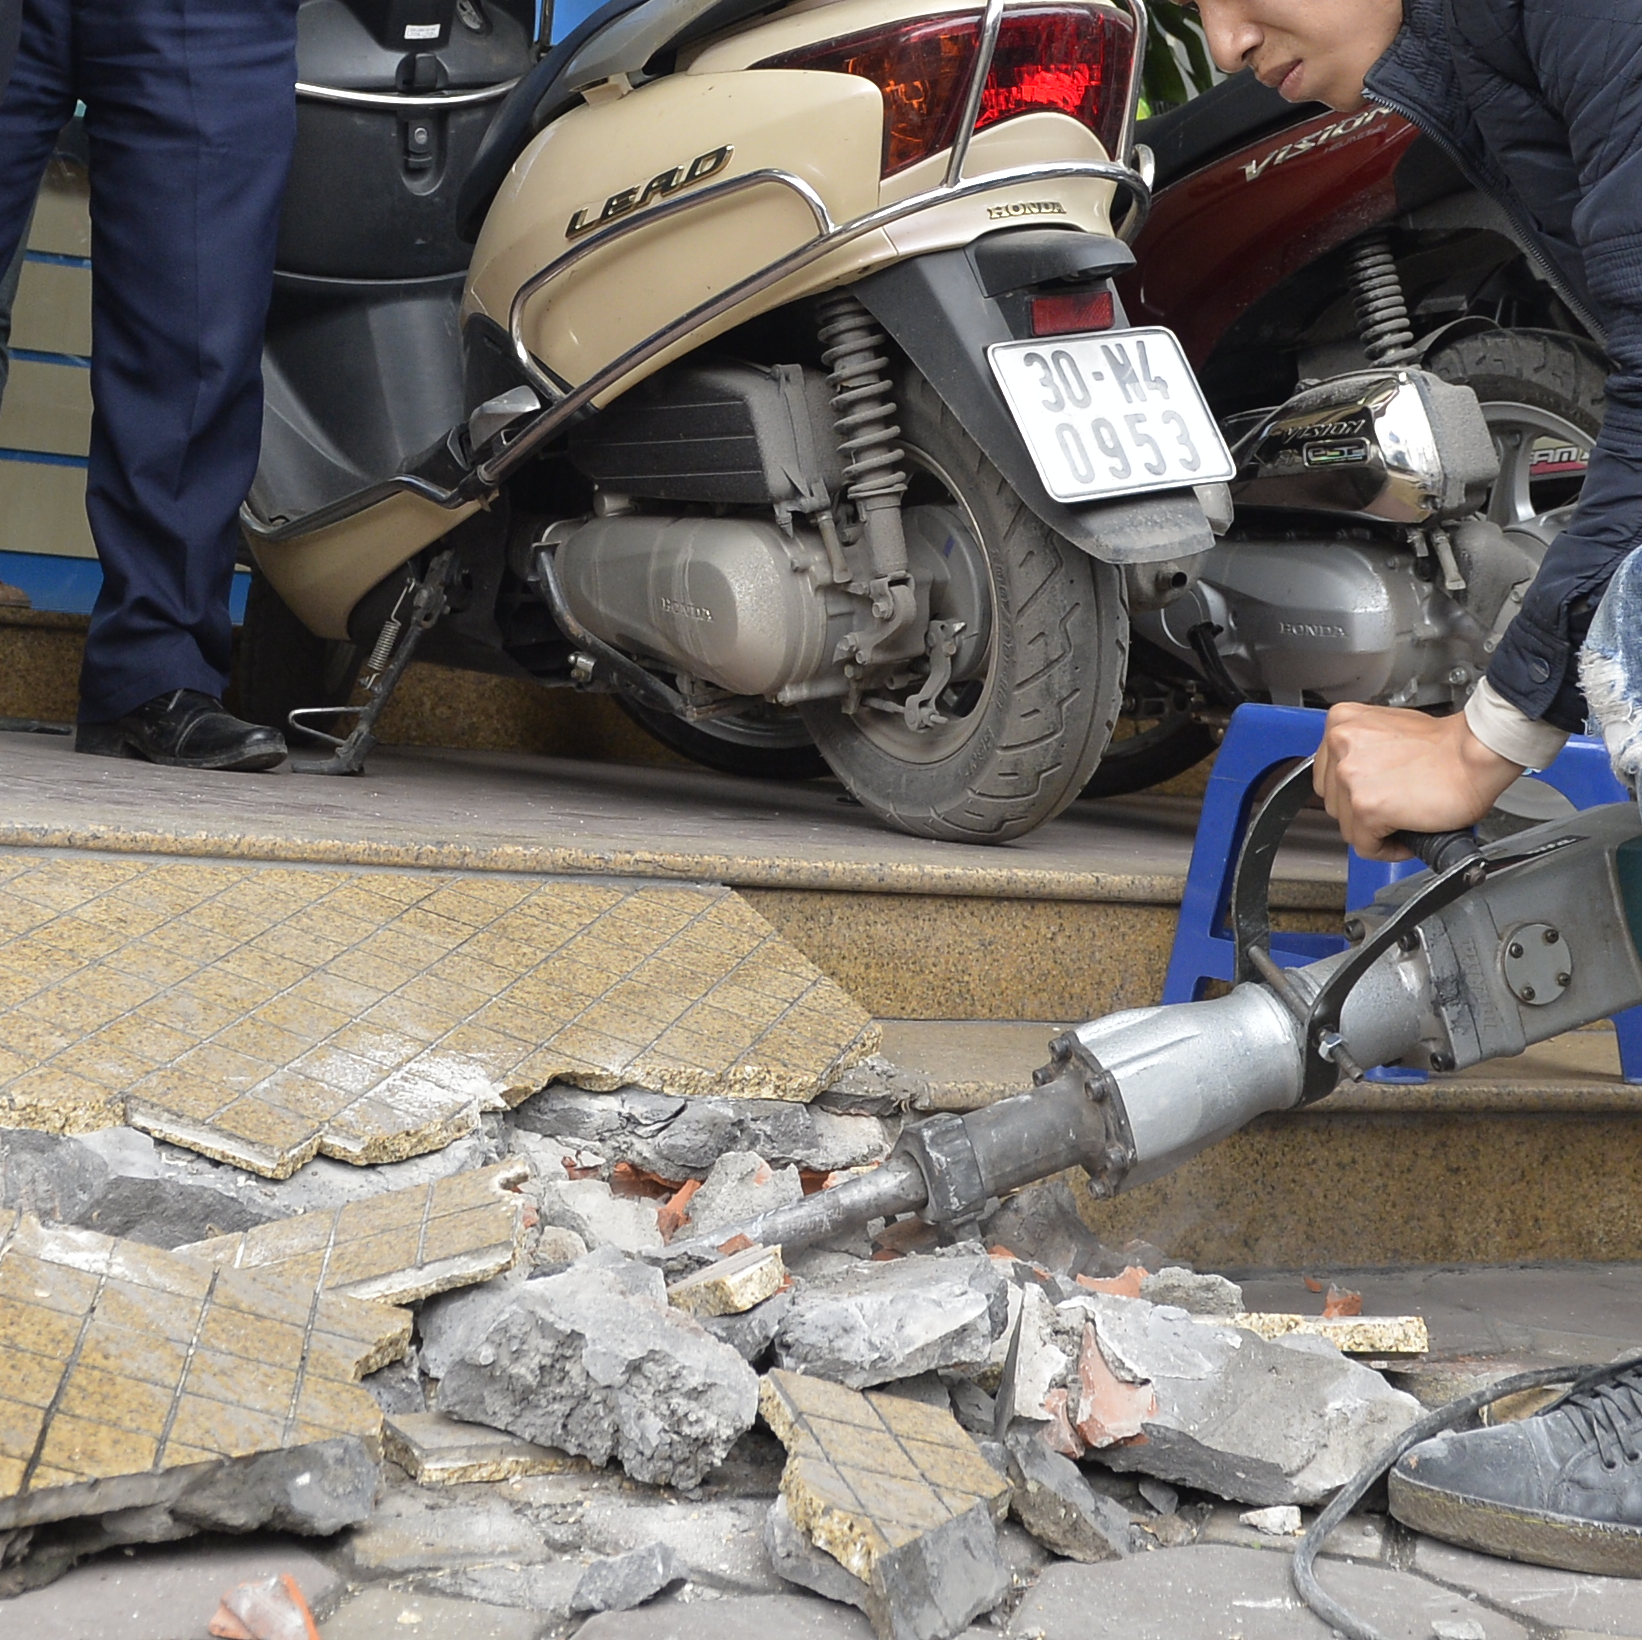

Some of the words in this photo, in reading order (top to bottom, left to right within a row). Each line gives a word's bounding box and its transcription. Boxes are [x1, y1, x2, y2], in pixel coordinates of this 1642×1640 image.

[565, 143, 735, 241] LEAD
[986, 201, 1068, 221] HONDA
[1023, 339, 1171, 414] 30-N4
[1054, 410, 1201, 484] 0953
[1283, 418, 1367, 445] VISION
[1278, 621, 1350, 640] HONDA
